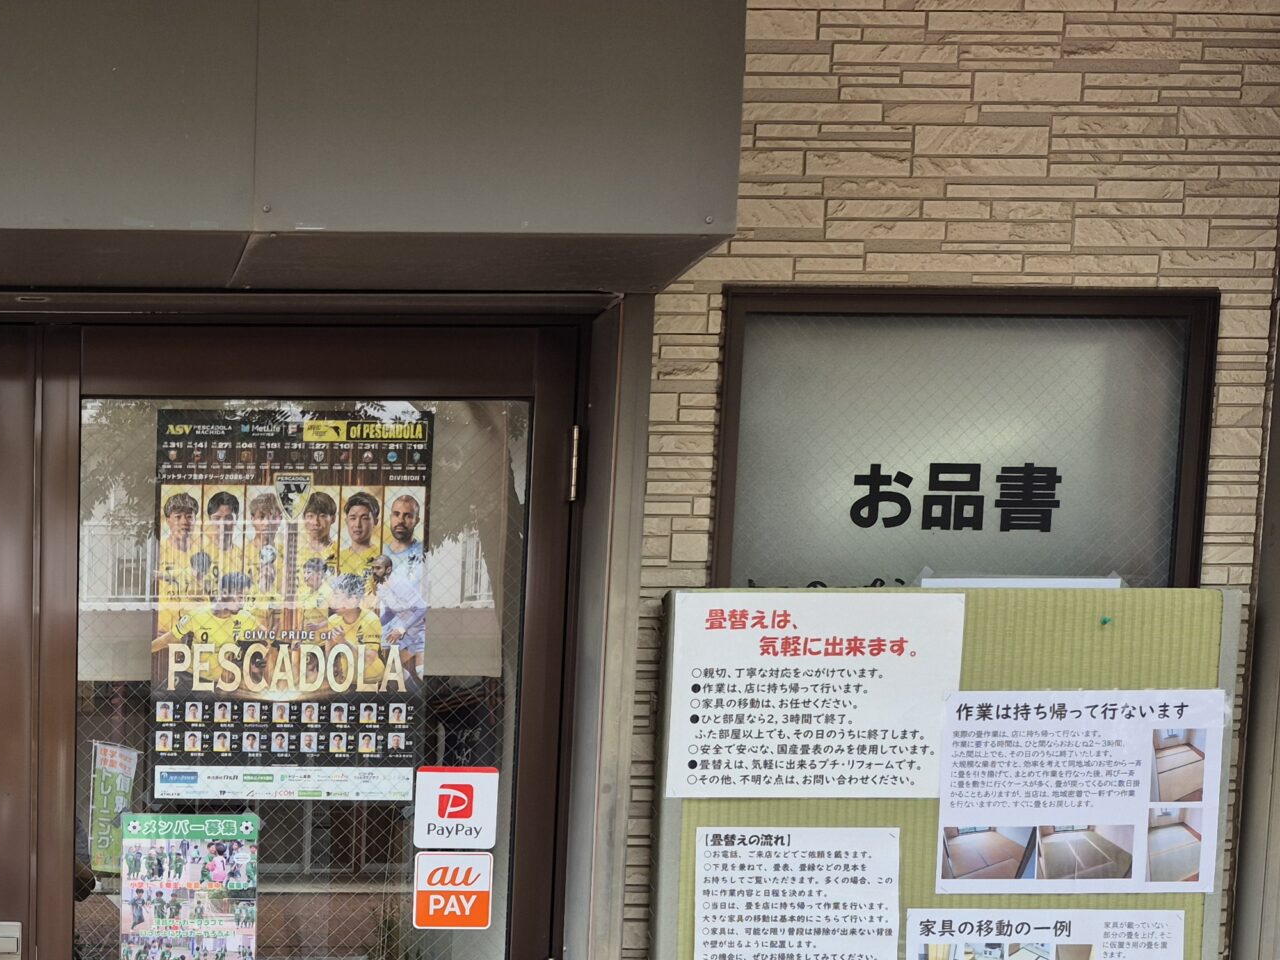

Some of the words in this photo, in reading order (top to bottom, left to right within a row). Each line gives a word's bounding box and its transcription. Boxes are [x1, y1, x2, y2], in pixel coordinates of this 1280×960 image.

[363, 424, 423, 439] PESCADOLA
[849, 462, 1062, 532] お品書
[705, 608, 798, 631] 畳替えは、
[245, 631, 276, 640] CIVIC
[281, 631, 315, 640] PRIDE
[320, 630, 332, 640] of
[760, 636, 918, 658] 気軽に出来ます。
[167, 643, 407, 692] PESCADOLA
[956, 702, 1189, 722] 作業は持ち帰って行ないます
[142, 820, 237, 835] メンバー募集
[427, 823, 482, 838] PayPay
[427, 866, 481, 887] au
[429, 895, 477, 916] PAY
[919, 919, 1072, 937] 家具の移動の一例
